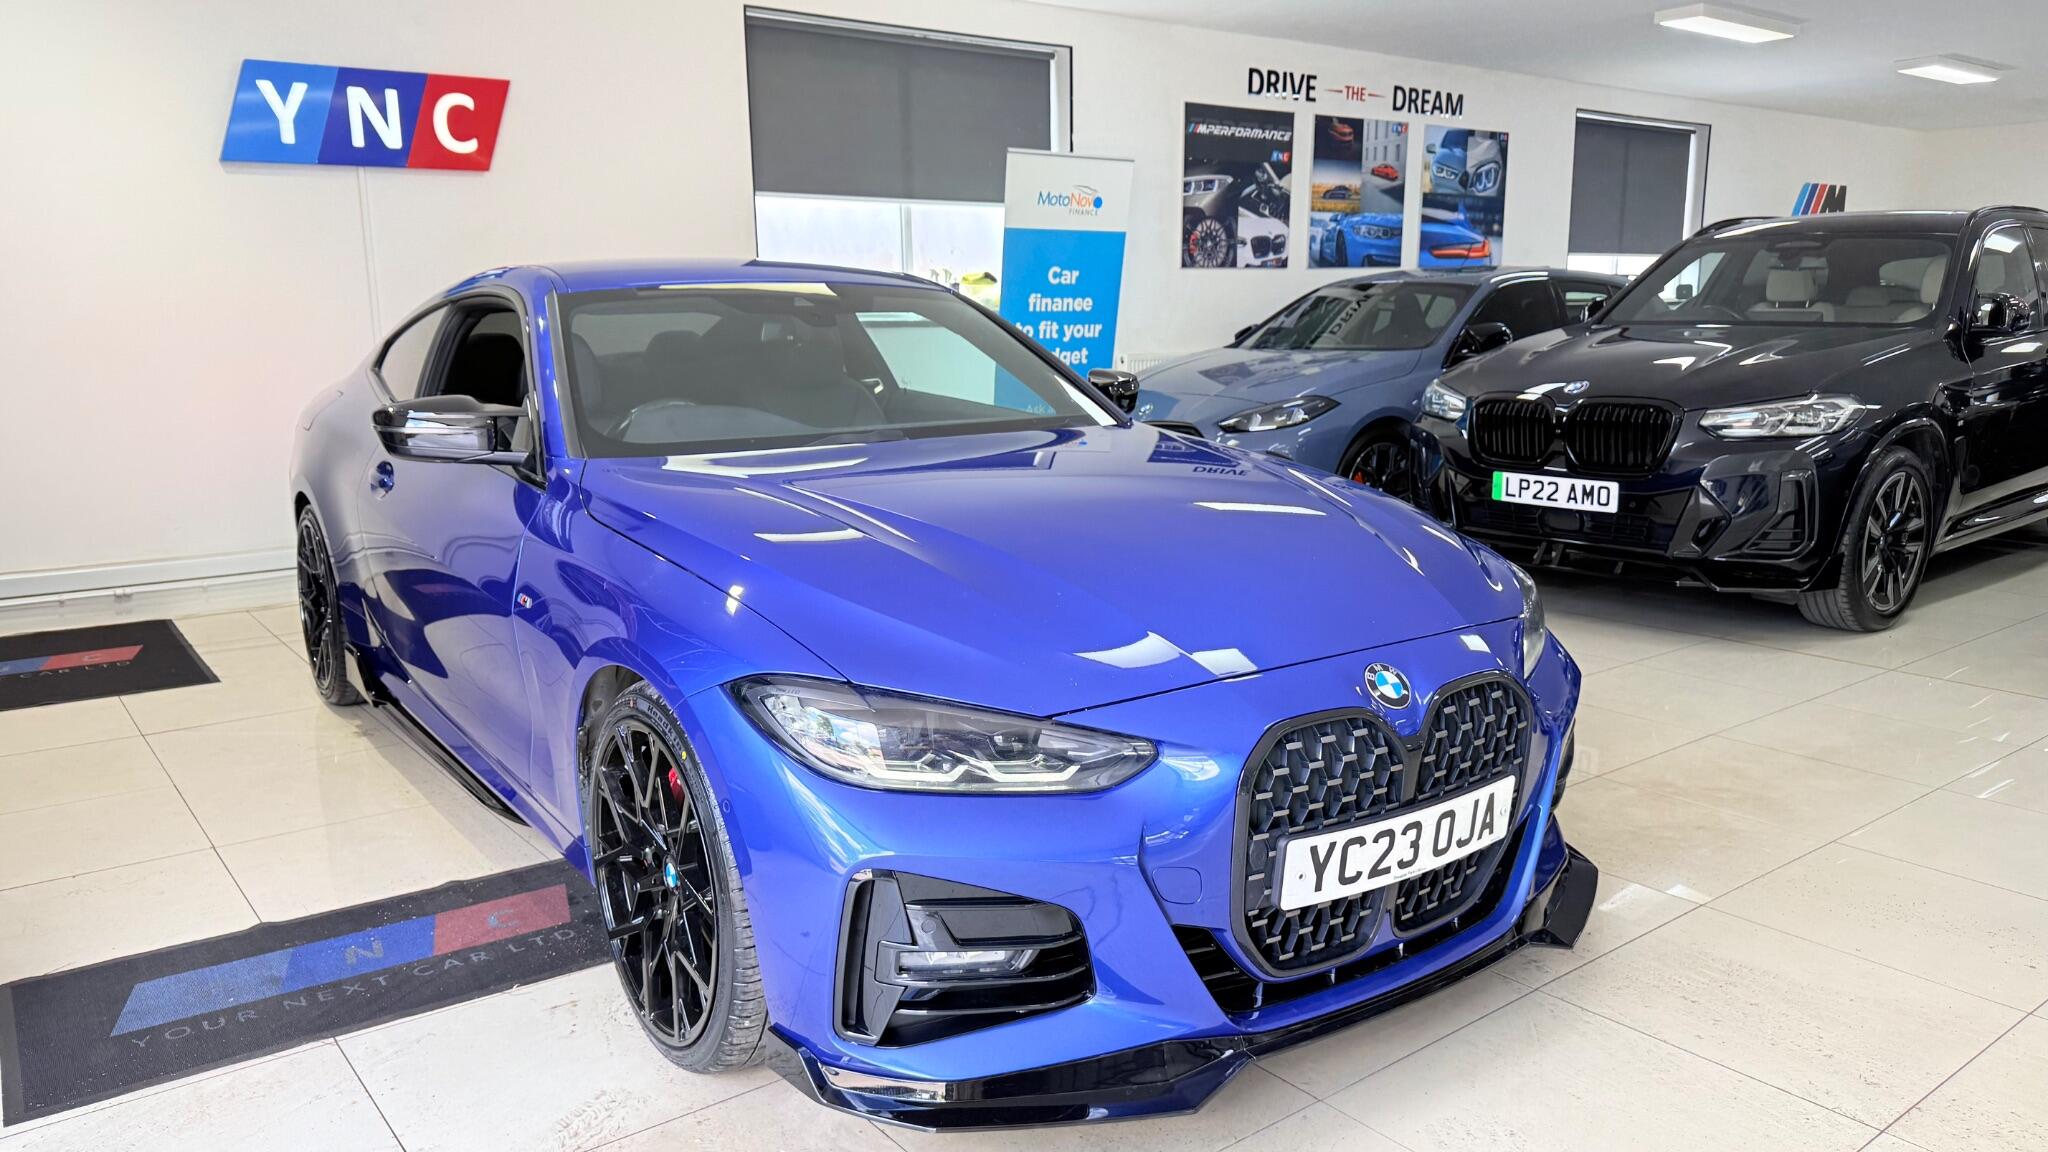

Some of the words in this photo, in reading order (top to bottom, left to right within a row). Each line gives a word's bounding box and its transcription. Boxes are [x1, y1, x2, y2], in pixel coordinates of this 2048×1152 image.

[1248, 67, 1317, 102] DRIVE
[1345, 84, 1366, 102] THE
[1392, 85, 1464, 116] DREAM
[255, 79, 478, 154] YNC
[1048, 265, 1080, 285] Car
[1028, 292, 1094, 312] finance
[1038, 320, 1060, 339] fit
[1062, 322, 1103, 343] your
[1051, 347, 1089, 366] dget
[1505, 476, 1560, 502] LP22
[1566, 483, 1611, 507] AMO
[1366, 662, 1398, 682] BMW
[1309, 819, 1423, 893] YC23
[1432, 792, 1496, 858] OJA
[131, 1008, 259, 1048] YOUR
[283, 973, 389, 1011] NEXT
[412, 949, 490, 977] CAR
[509, 928, 578, 953] LTD
